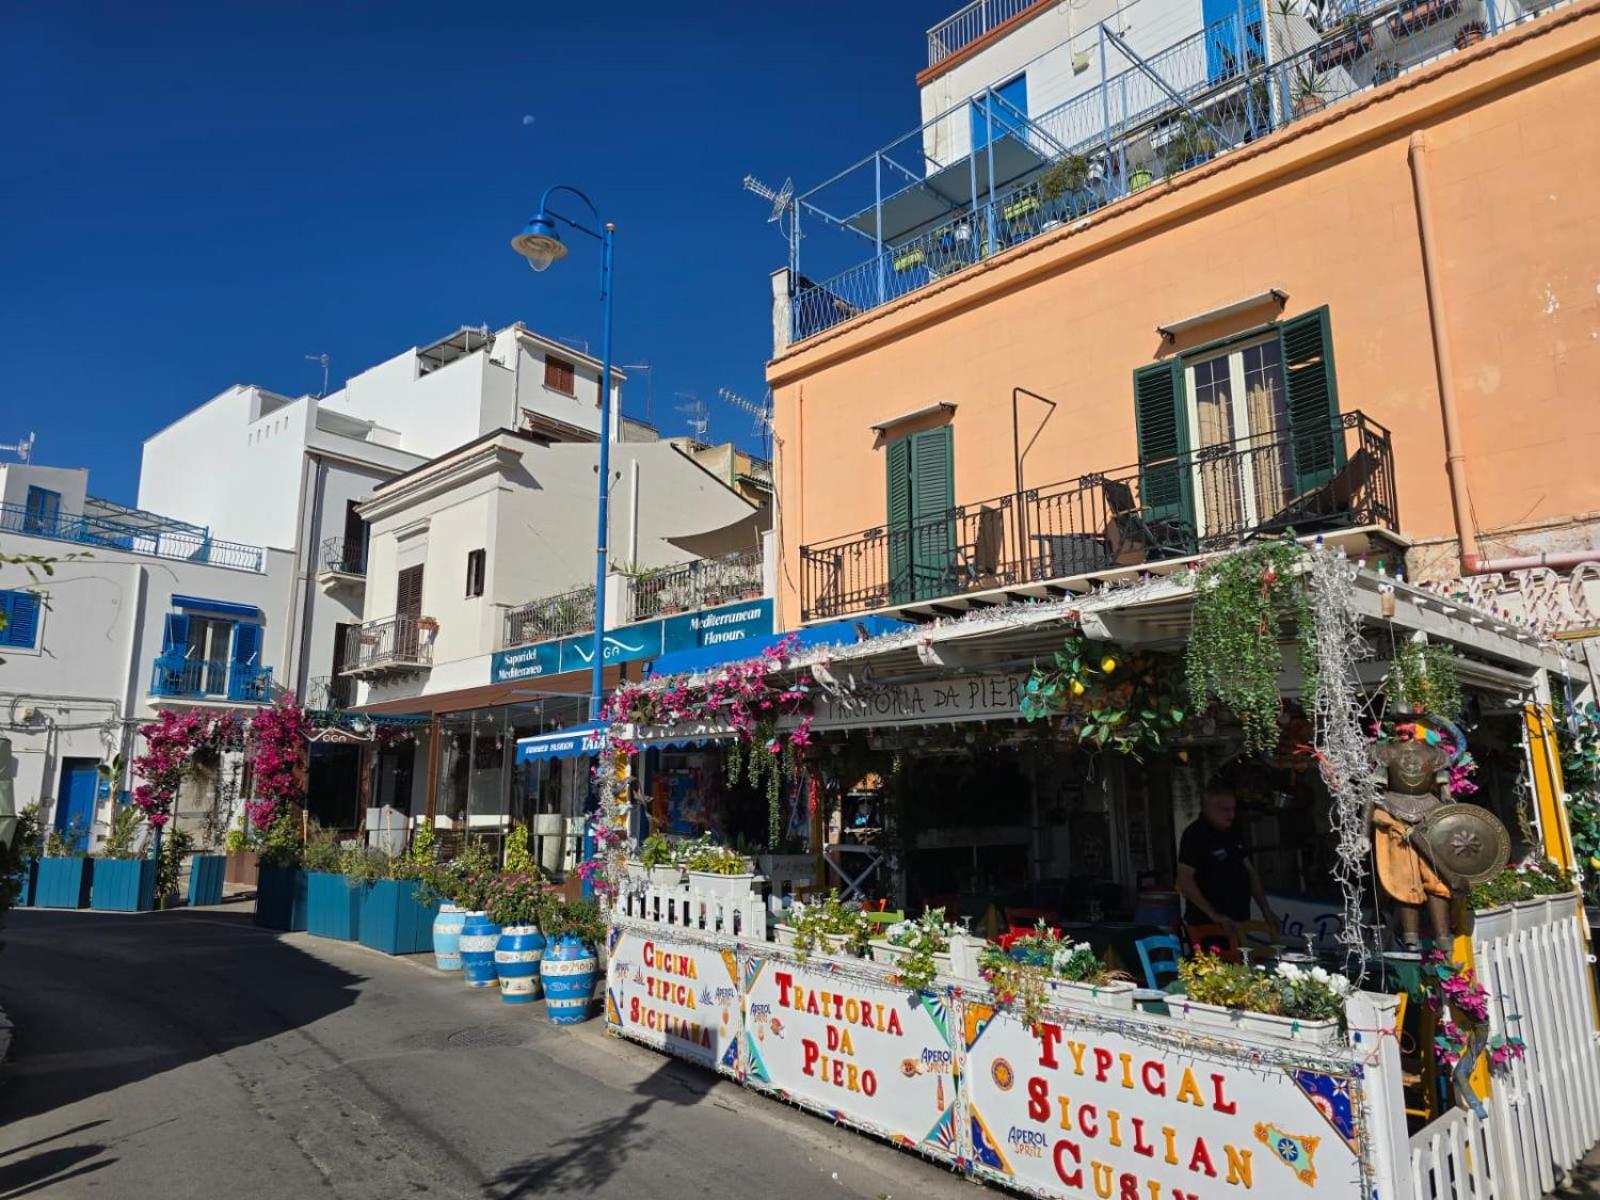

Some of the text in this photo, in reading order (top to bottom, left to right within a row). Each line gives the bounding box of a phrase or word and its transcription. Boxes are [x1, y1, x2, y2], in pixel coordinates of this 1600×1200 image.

[689, 607, 762, 630] Mediterranean
[703, 629, 745, 646] Flavours
[498, 665, 542, 679] Mediterraneo
[504, 648, 537, 666] Sapori del
[933, 685, 960, 708] DA
[968, 676, 1026, 709] PIER
[643, 939, 698, 980] CUCINA
[646, 976, 696, 1009] TIPICA
[775, 971, 903, 1036] TRATTORIA
[630, 996, 712, 1048] SICILIANA
[826, 1024, 854, 1056] DA
[801, 1038, 877, 1097] PIERO
[1031, 1021, 1237, 1115] TYPICAL
[1008, 1126, 1048, 1147] APEROL
[1028, 1076, 1253, 1189] SICILIAN
[1053, 1138, 1199, 1200] CUSI
